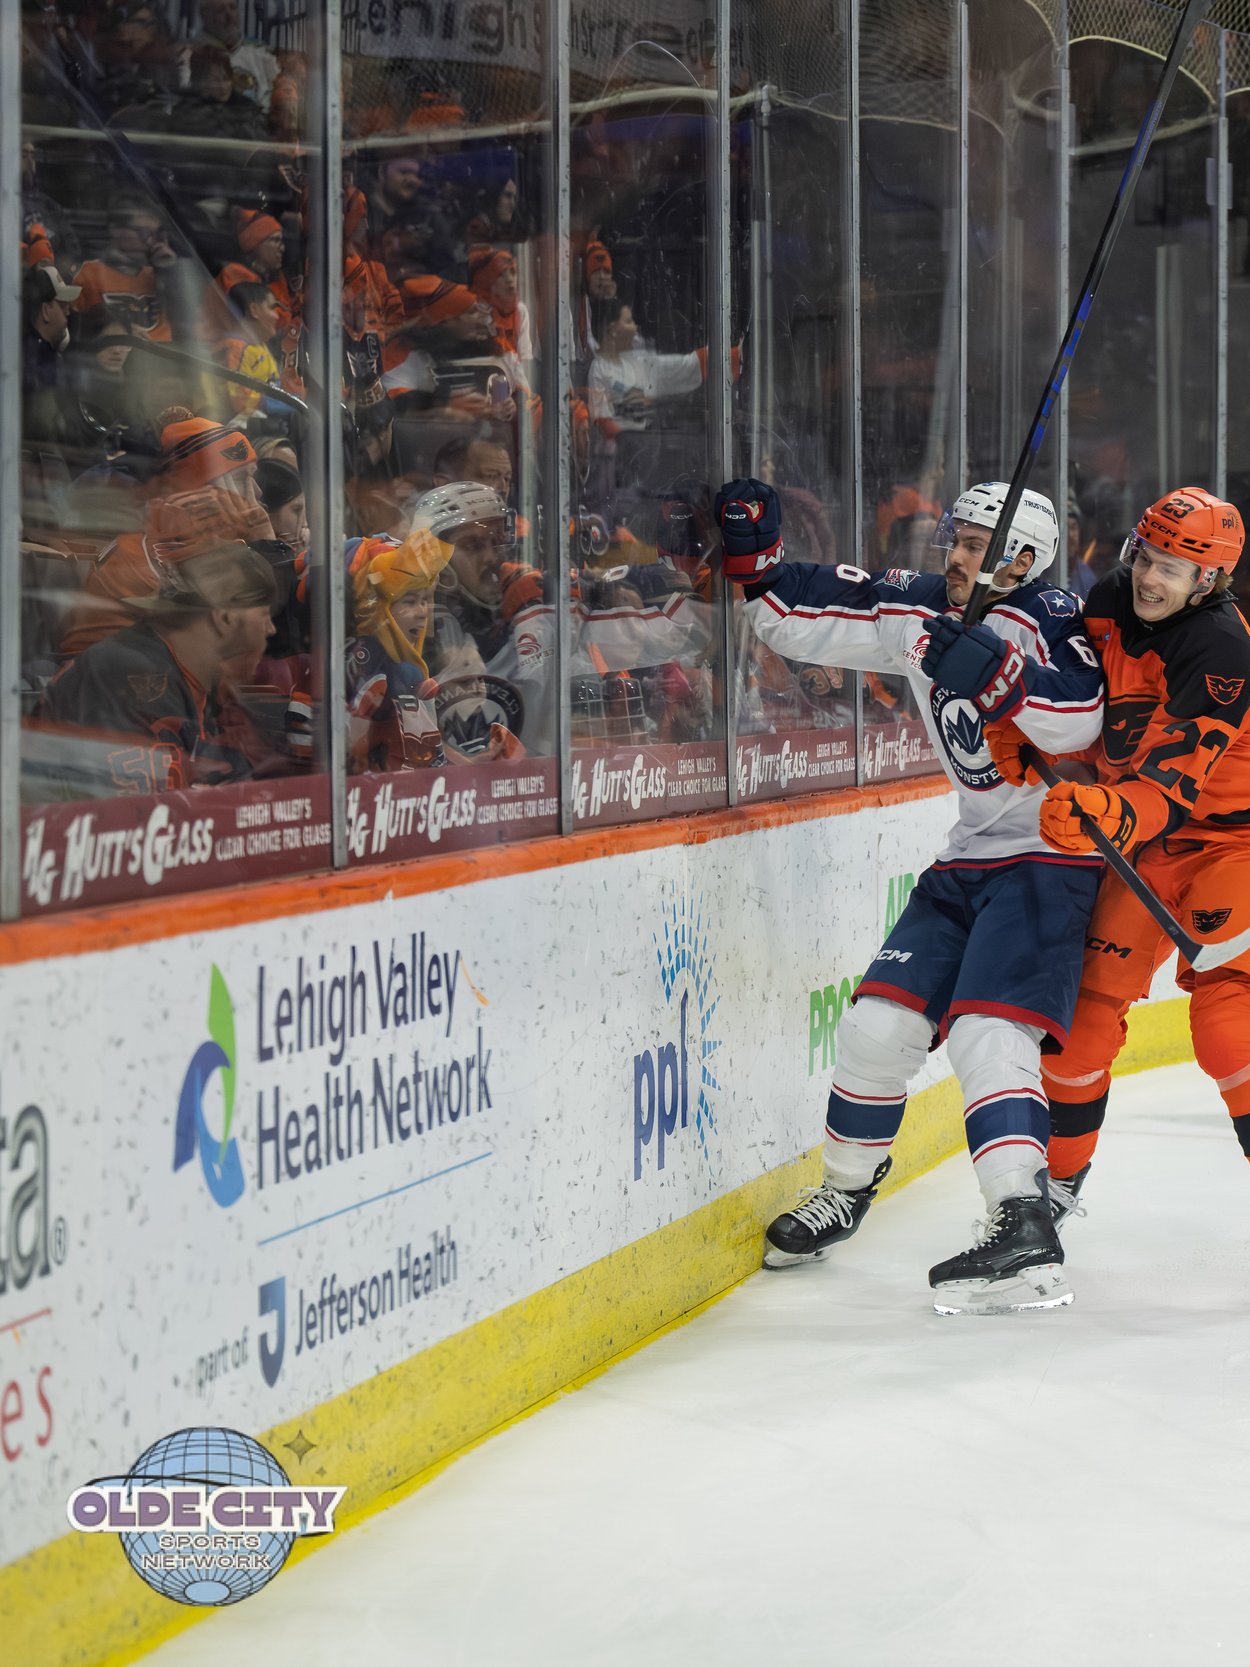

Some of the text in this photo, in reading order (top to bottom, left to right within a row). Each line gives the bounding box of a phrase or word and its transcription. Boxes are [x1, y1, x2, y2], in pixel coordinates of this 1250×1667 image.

[958, 497, 980, 506] CCM
[1161, 498, 1195, 519] 23
[1150, 521, 1178, 538] CCM
[1222, 517, 1235, 529] ppl
[1067, 635, 1099, 668] 6
[816, 740, 847, 757] LEHIGH VALLEY'S
[874, 731, 899, 777] HUTT'S
[898, 728, 921, 772] GLASS
[1137, 720, 1230, 805] 23
[677, 756, 716, 776] LEHIGH VALLEY'S
[749, 743, 781, 795] HUTT'S
[779, 740, 808, 788] GLASS
[808, 756, 856, 777] CLEAR CHOICE FOR GLASS
[590, 757, 631, 818] HUTT'S
[630, 753, 666, 810] GLASS
[667, 775, 727, 797] CLEAR CHOICE FOR GLASS
[371, 783, 429, 855] HUTT'S
[427, 776, 478, 843] GLASS
[303, 822, 332, 846] GLASS
[60, 812, 144, 901] HUTT'S
[142, 804, 214, 885] GLASS
[1086, 936, 1133, 959] CM
[258, 931, 461, 1066] Lehigh Valley
[633, 987, 688, 1182] ppl
[258, 1025, 492, 1189] Health Network
[295, 1224, 458, 1356] Jefferson Health
